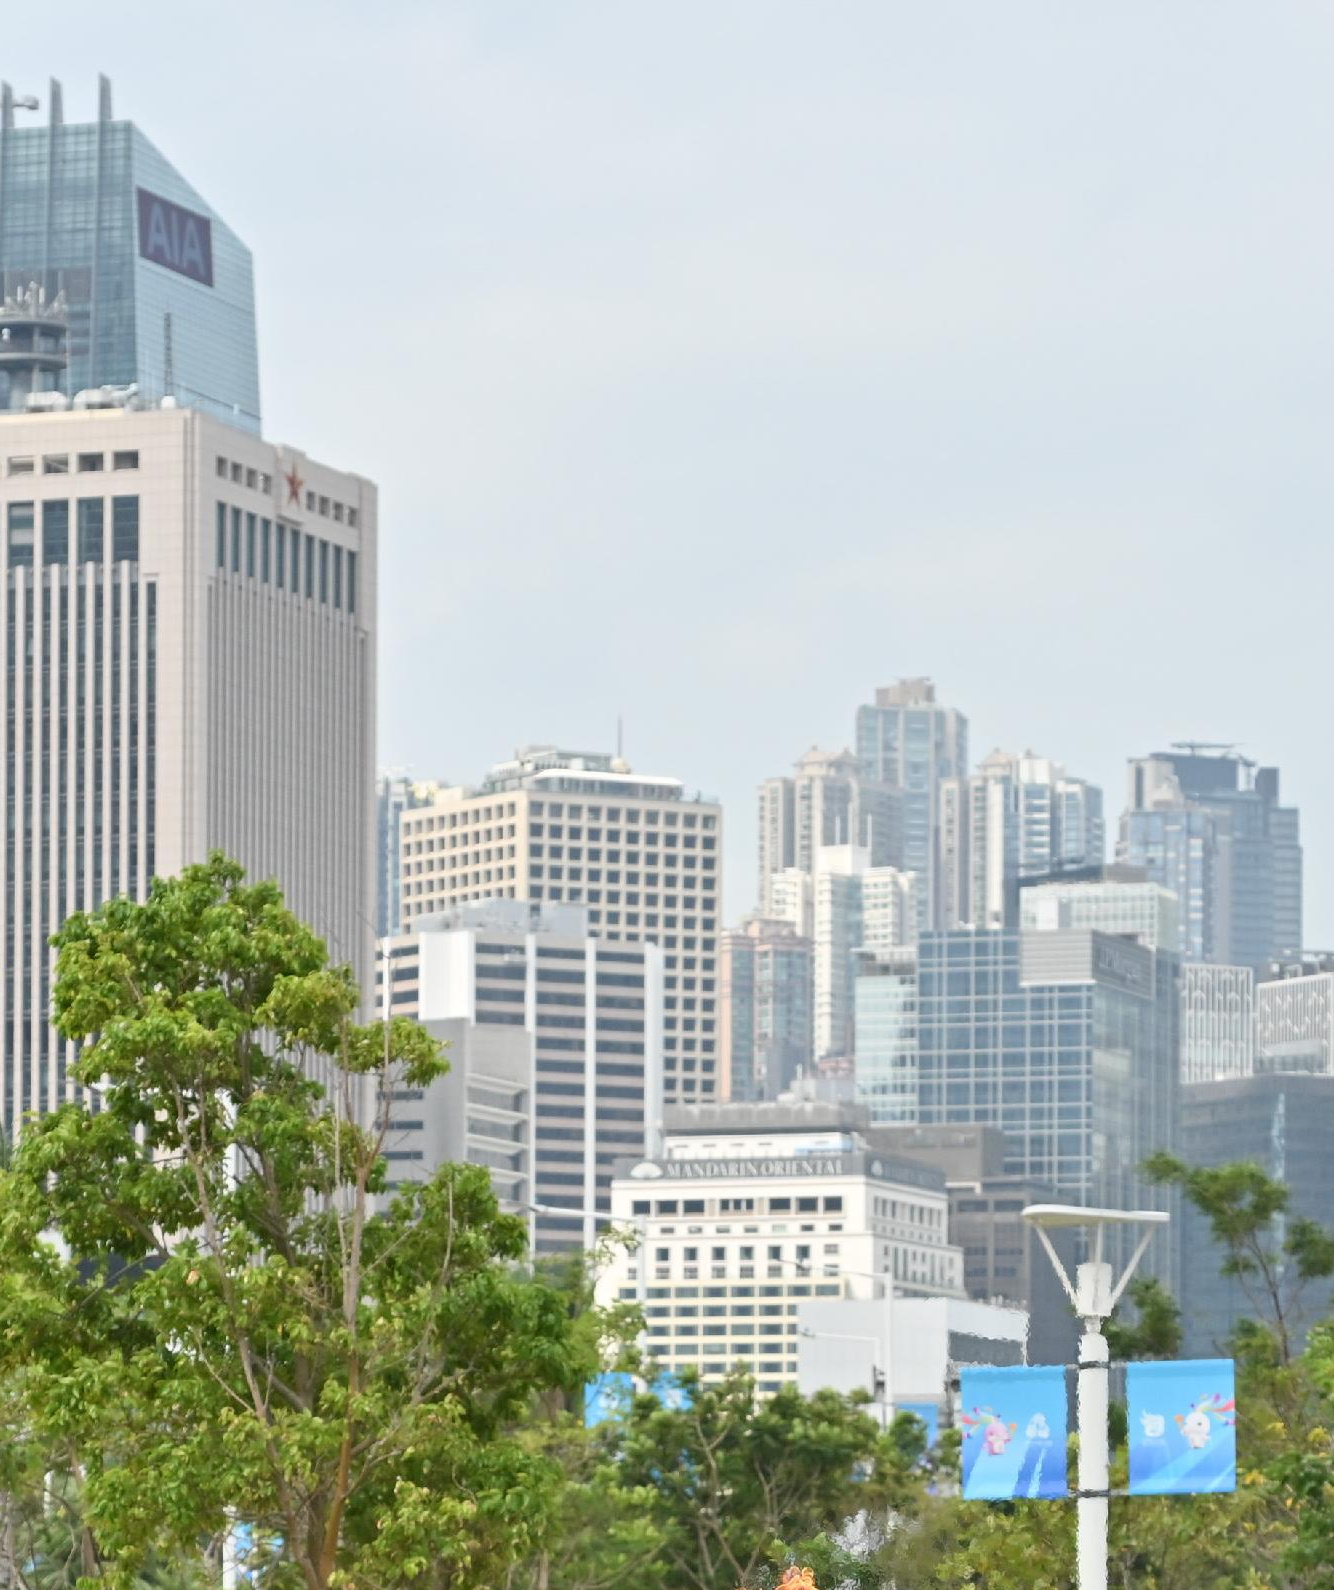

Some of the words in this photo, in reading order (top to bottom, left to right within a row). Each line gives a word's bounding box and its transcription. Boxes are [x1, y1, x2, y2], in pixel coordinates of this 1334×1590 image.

[147, 202, 206, 278] AIA
[666, 1161, 758, 1179] MANDARIN
[759, 1158, 843, 1178] ORIENTAL
